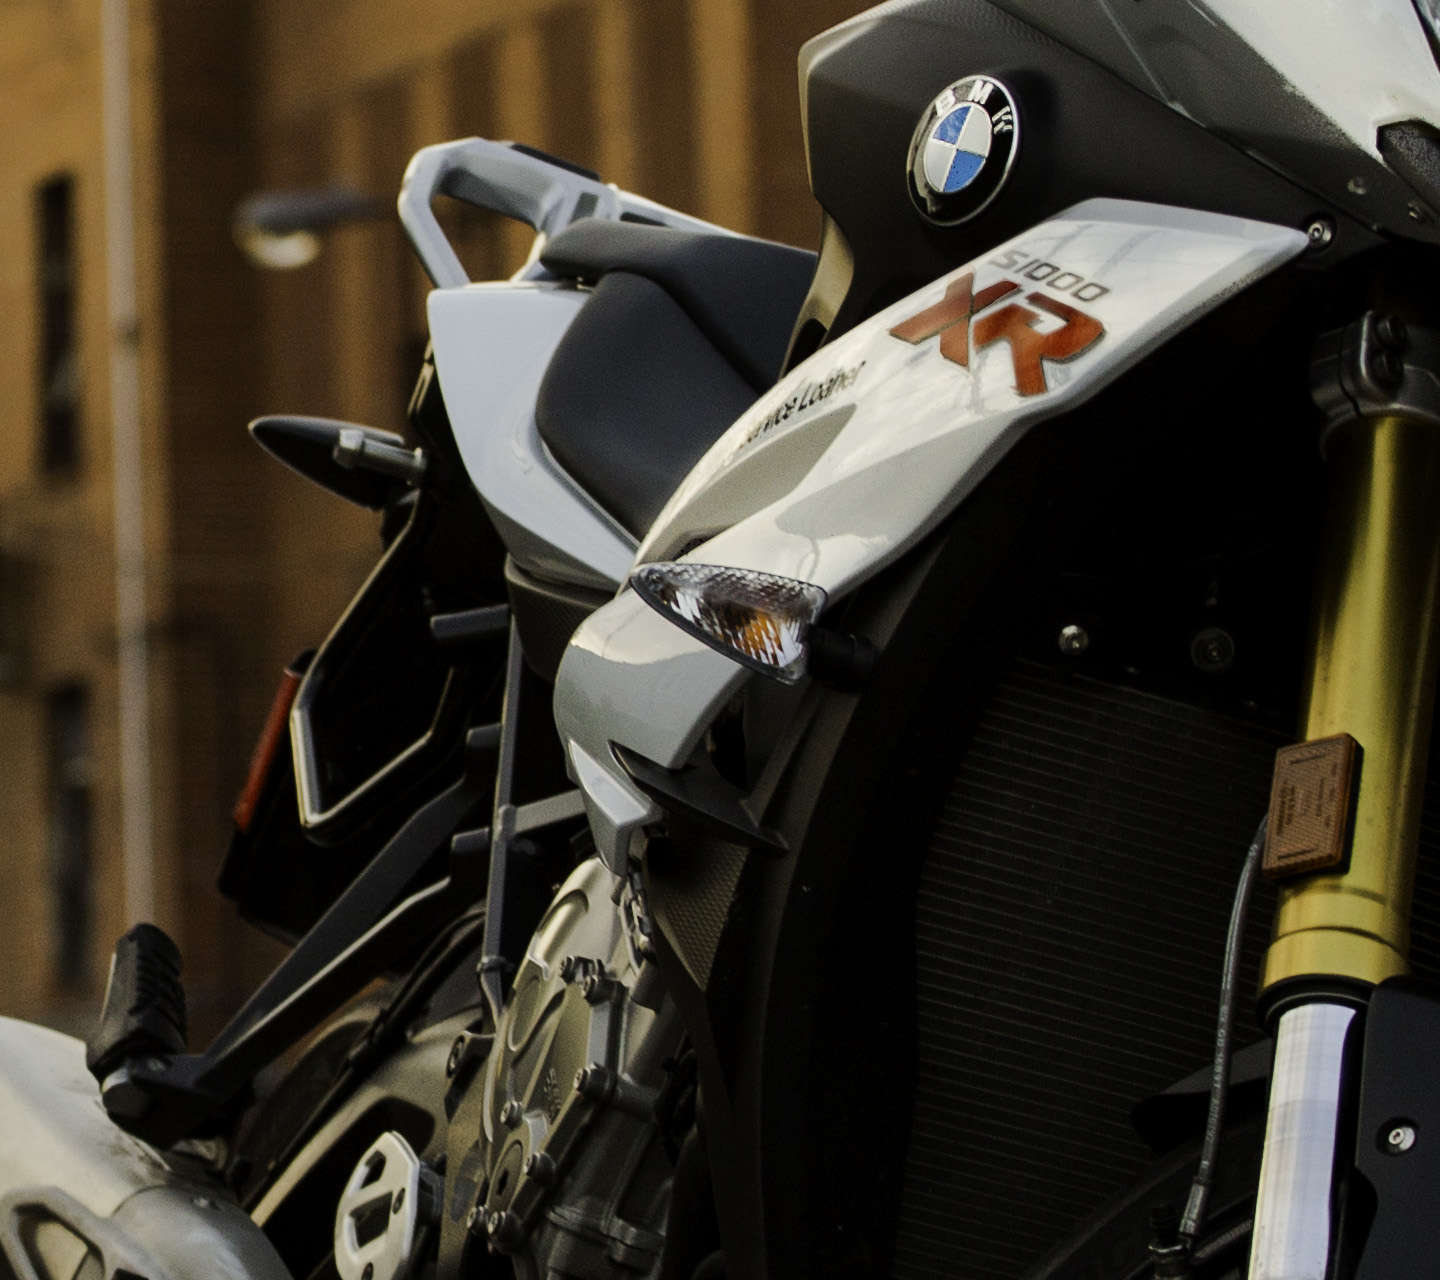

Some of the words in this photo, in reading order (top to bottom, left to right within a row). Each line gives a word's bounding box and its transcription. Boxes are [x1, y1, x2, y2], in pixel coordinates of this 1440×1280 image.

[935, 79, 1013, 135] BMW
[988, 250, 1110, 303] S1000
[889, 271, 1106, 397] XR
